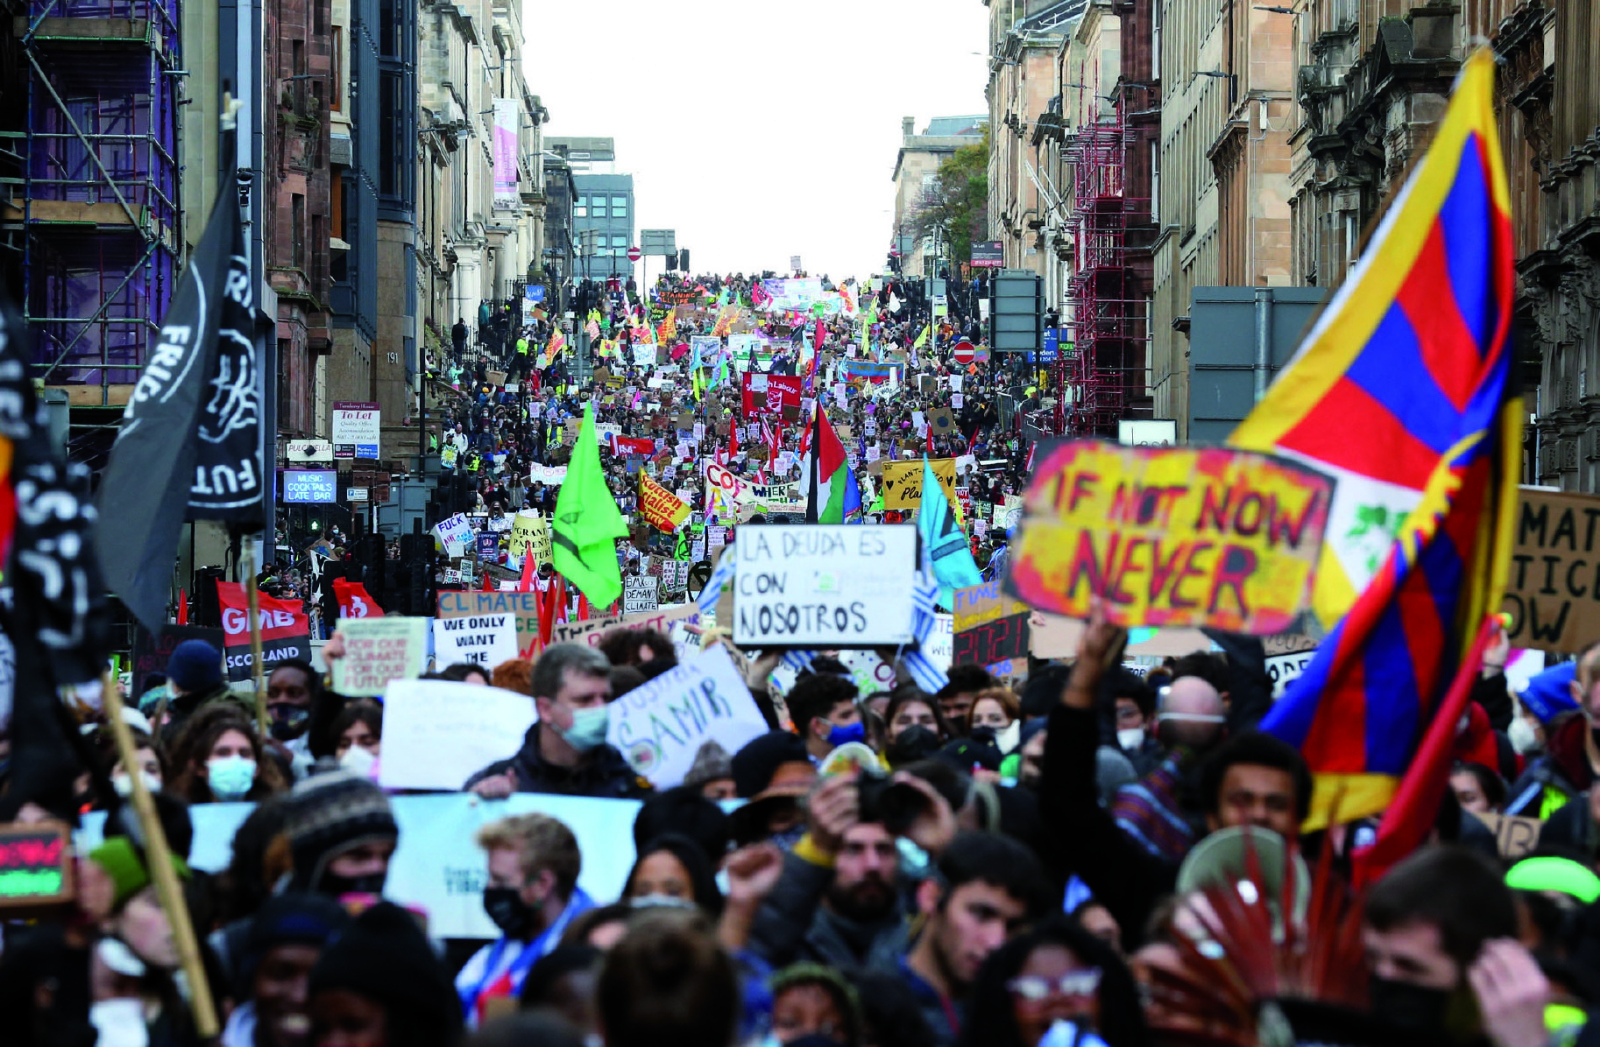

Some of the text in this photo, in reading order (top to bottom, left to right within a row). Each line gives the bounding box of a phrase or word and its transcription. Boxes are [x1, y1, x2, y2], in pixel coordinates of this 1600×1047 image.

[386, 352, 398, 364] 191
[341, 410, 372, 420] To Let
[298, 474, 323, 482] MUSIC
[706, 464, 747, 498] COP
[288, 482, 332, 492] COCKTAILS
[288, 492, 332, 500] LATE BAR
[1054, 470, 1318, 549] IF NOT NOW
[438, 515, 464, 532] FUCK
[743, 530, 772, 561] LA
[783, 531, 846, 558] DEUDA
[859, 530, 886, 556] ES
[1068, 529, 1258, 621] NEVER
[740, 573, 787, 596] CON
[626, 590, 656, 600] DEMAND
[956, 582, 1000, 609] TIME
[626, 602, 657, 611] CLIMATE
[222, 608, 296, 635] GMB
[444, 617, 506, 631] WE ONLY
[740, 602, 867, 638] NOSOTROS
[456, 634, 496, 648] WANT
[227, 646, 299, 668] SCOLAND
[465, 652, 489, 662] THE
